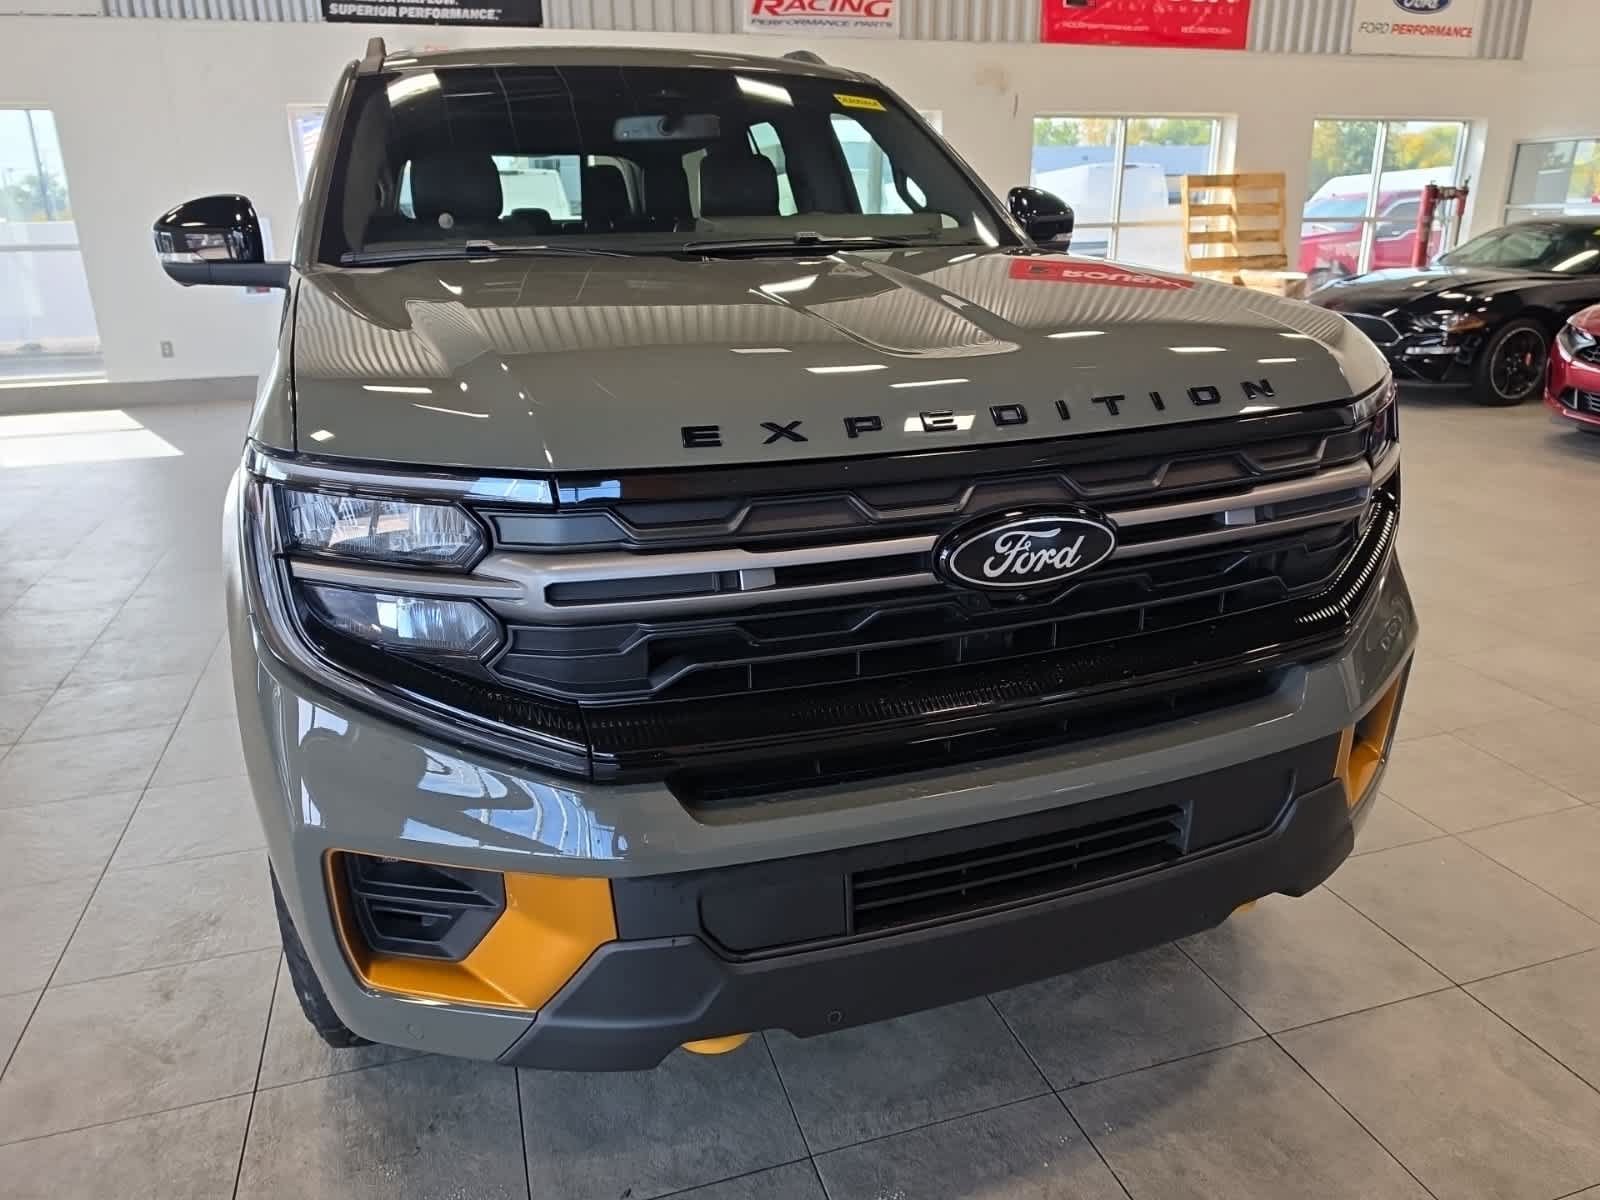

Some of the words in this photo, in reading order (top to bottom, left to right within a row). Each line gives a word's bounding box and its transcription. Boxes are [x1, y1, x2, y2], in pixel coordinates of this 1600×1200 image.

[329, 3, 397, 17] SUPERIOR
[752, 0, 892, 17] RACING
[750, 18, 849, 27] PERFORMANCE
[1359, 21, 1390, 34] FORD
[1391, 23, 1472, 38] PERFORMANCE
[681, 378, 1274, 448] EXPEDITION
[983, 527, 1085, 578] Ford
